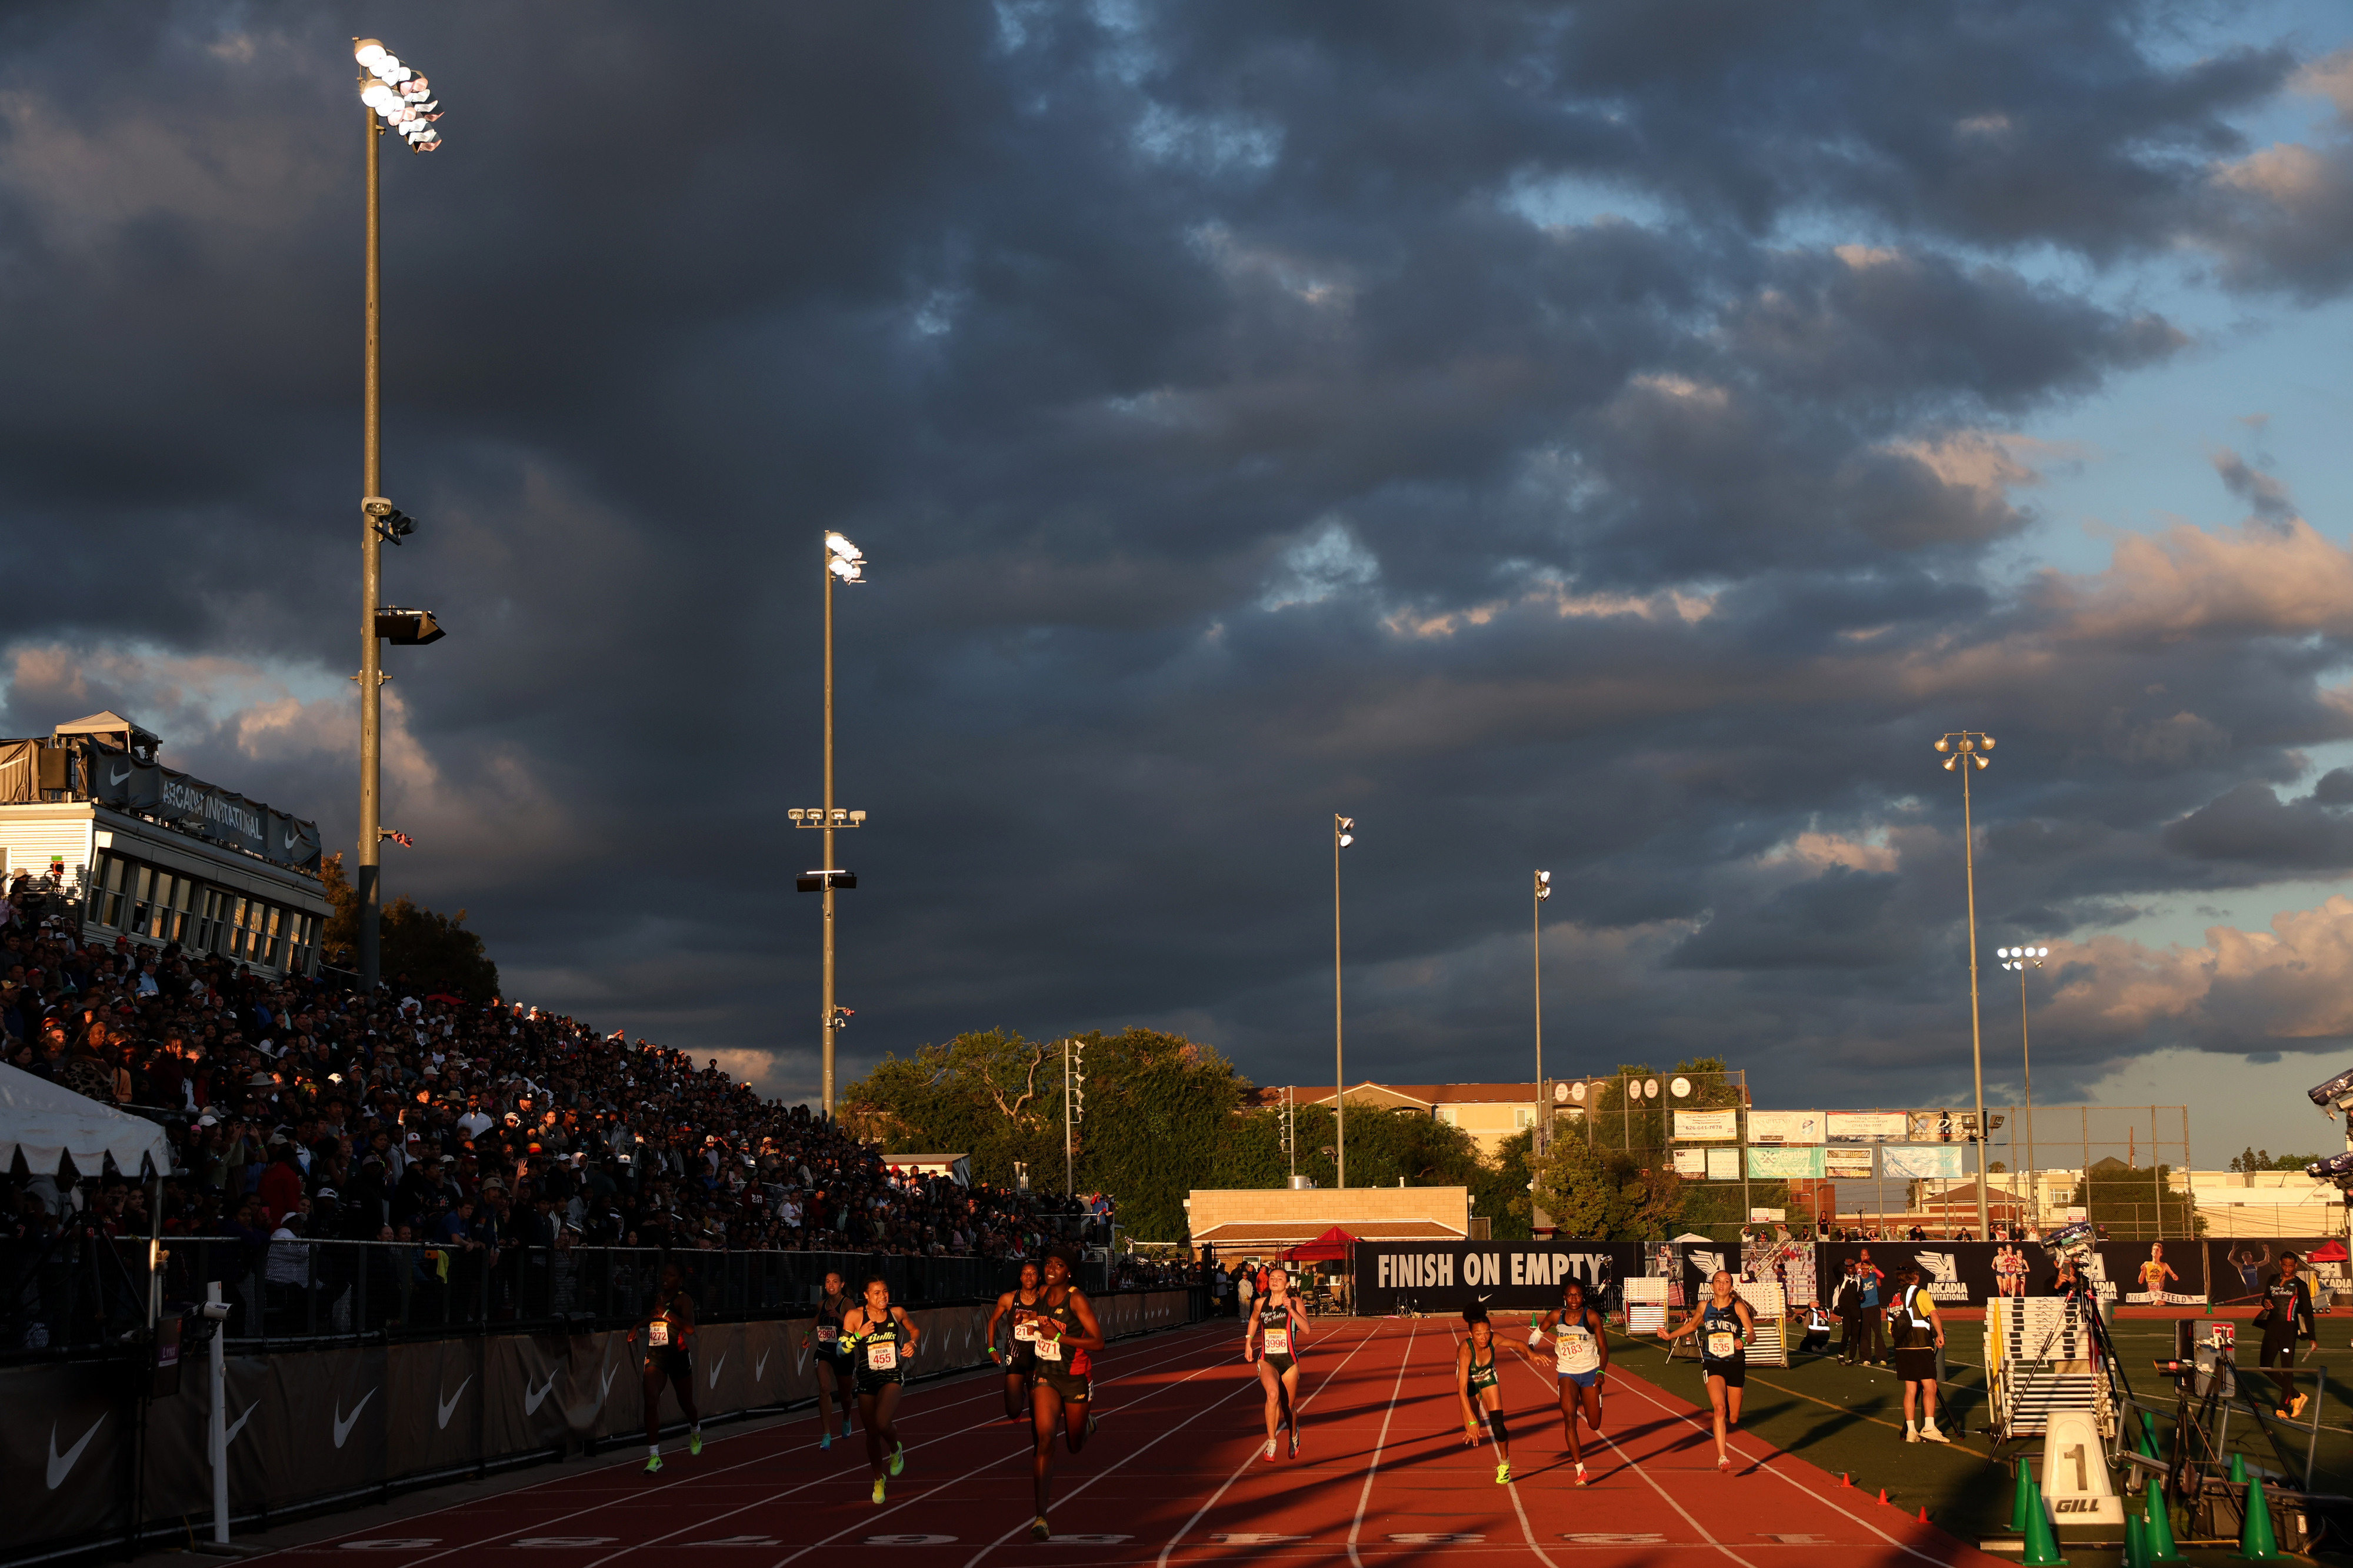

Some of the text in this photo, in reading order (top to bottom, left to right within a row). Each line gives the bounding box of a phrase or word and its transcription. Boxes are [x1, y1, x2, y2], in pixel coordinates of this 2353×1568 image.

[163, 780, 263, 840] ARCADIA INVITATIONAL
[1378, 1253, 1604, 1288] FINISH ON EMPTY
[1927, 1283, 1968, 1293] ARCADIA
[2161, 1293, 2187, 1303] FIELD
[1264, 1312, 1287, 1324] Catholic
[1717, 1320, 1737, 1333] VIEW
[650, 1332, 666, 1340] 4272
[866, 1332, 896, 1343] Bullis
[1036, 1339, 1056, 1355] 4271
[1266, 1339, 1286, 1348] 3996
[1713, 1343, 1729, 1352] 535
[162, 1346, 176, 1358] LYNX
[1561, 1345, 1583, 1356] 2183
[874, 1353, 891, 1364] 455
[2064, 1444, 2088, 1490] 1
[2055, 1499, 2099, 1513] GILL
